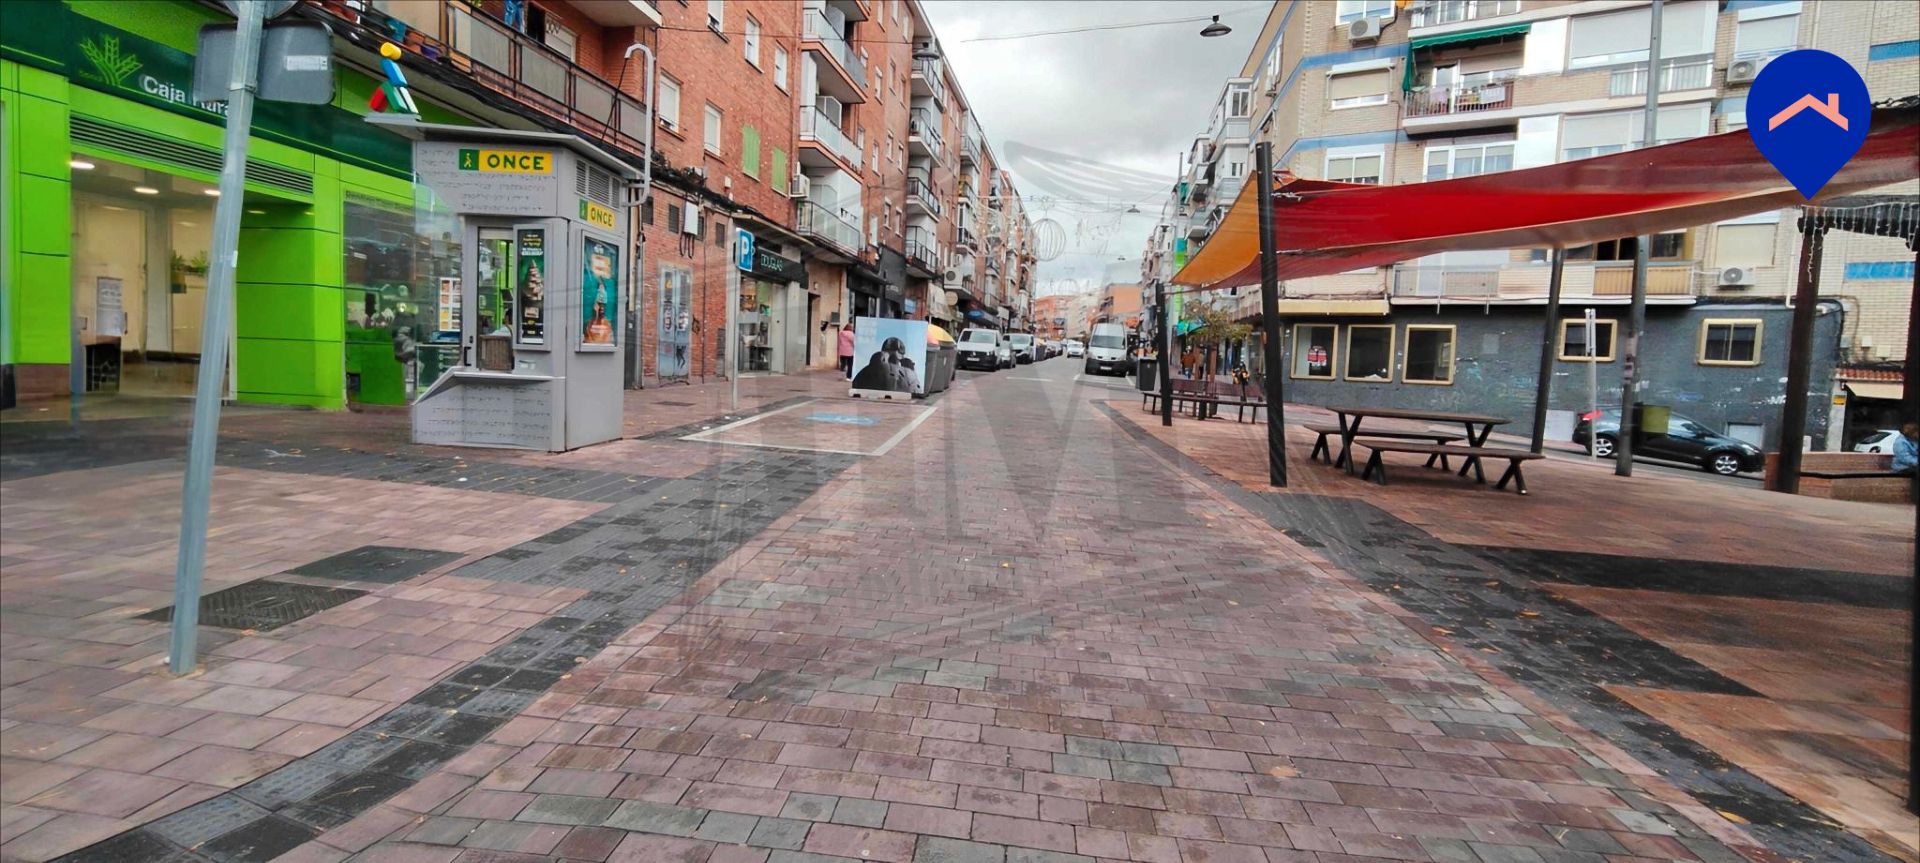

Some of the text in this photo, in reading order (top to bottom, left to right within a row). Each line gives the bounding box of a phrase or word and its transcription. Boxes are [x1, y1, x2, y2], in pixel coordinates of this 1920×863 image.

[143, 75, 186, 103] Caja
[487, 154, 545, 170] ONCE
[590, 207, 613, 227] ONCE
[740, 235, 750, 263] P
